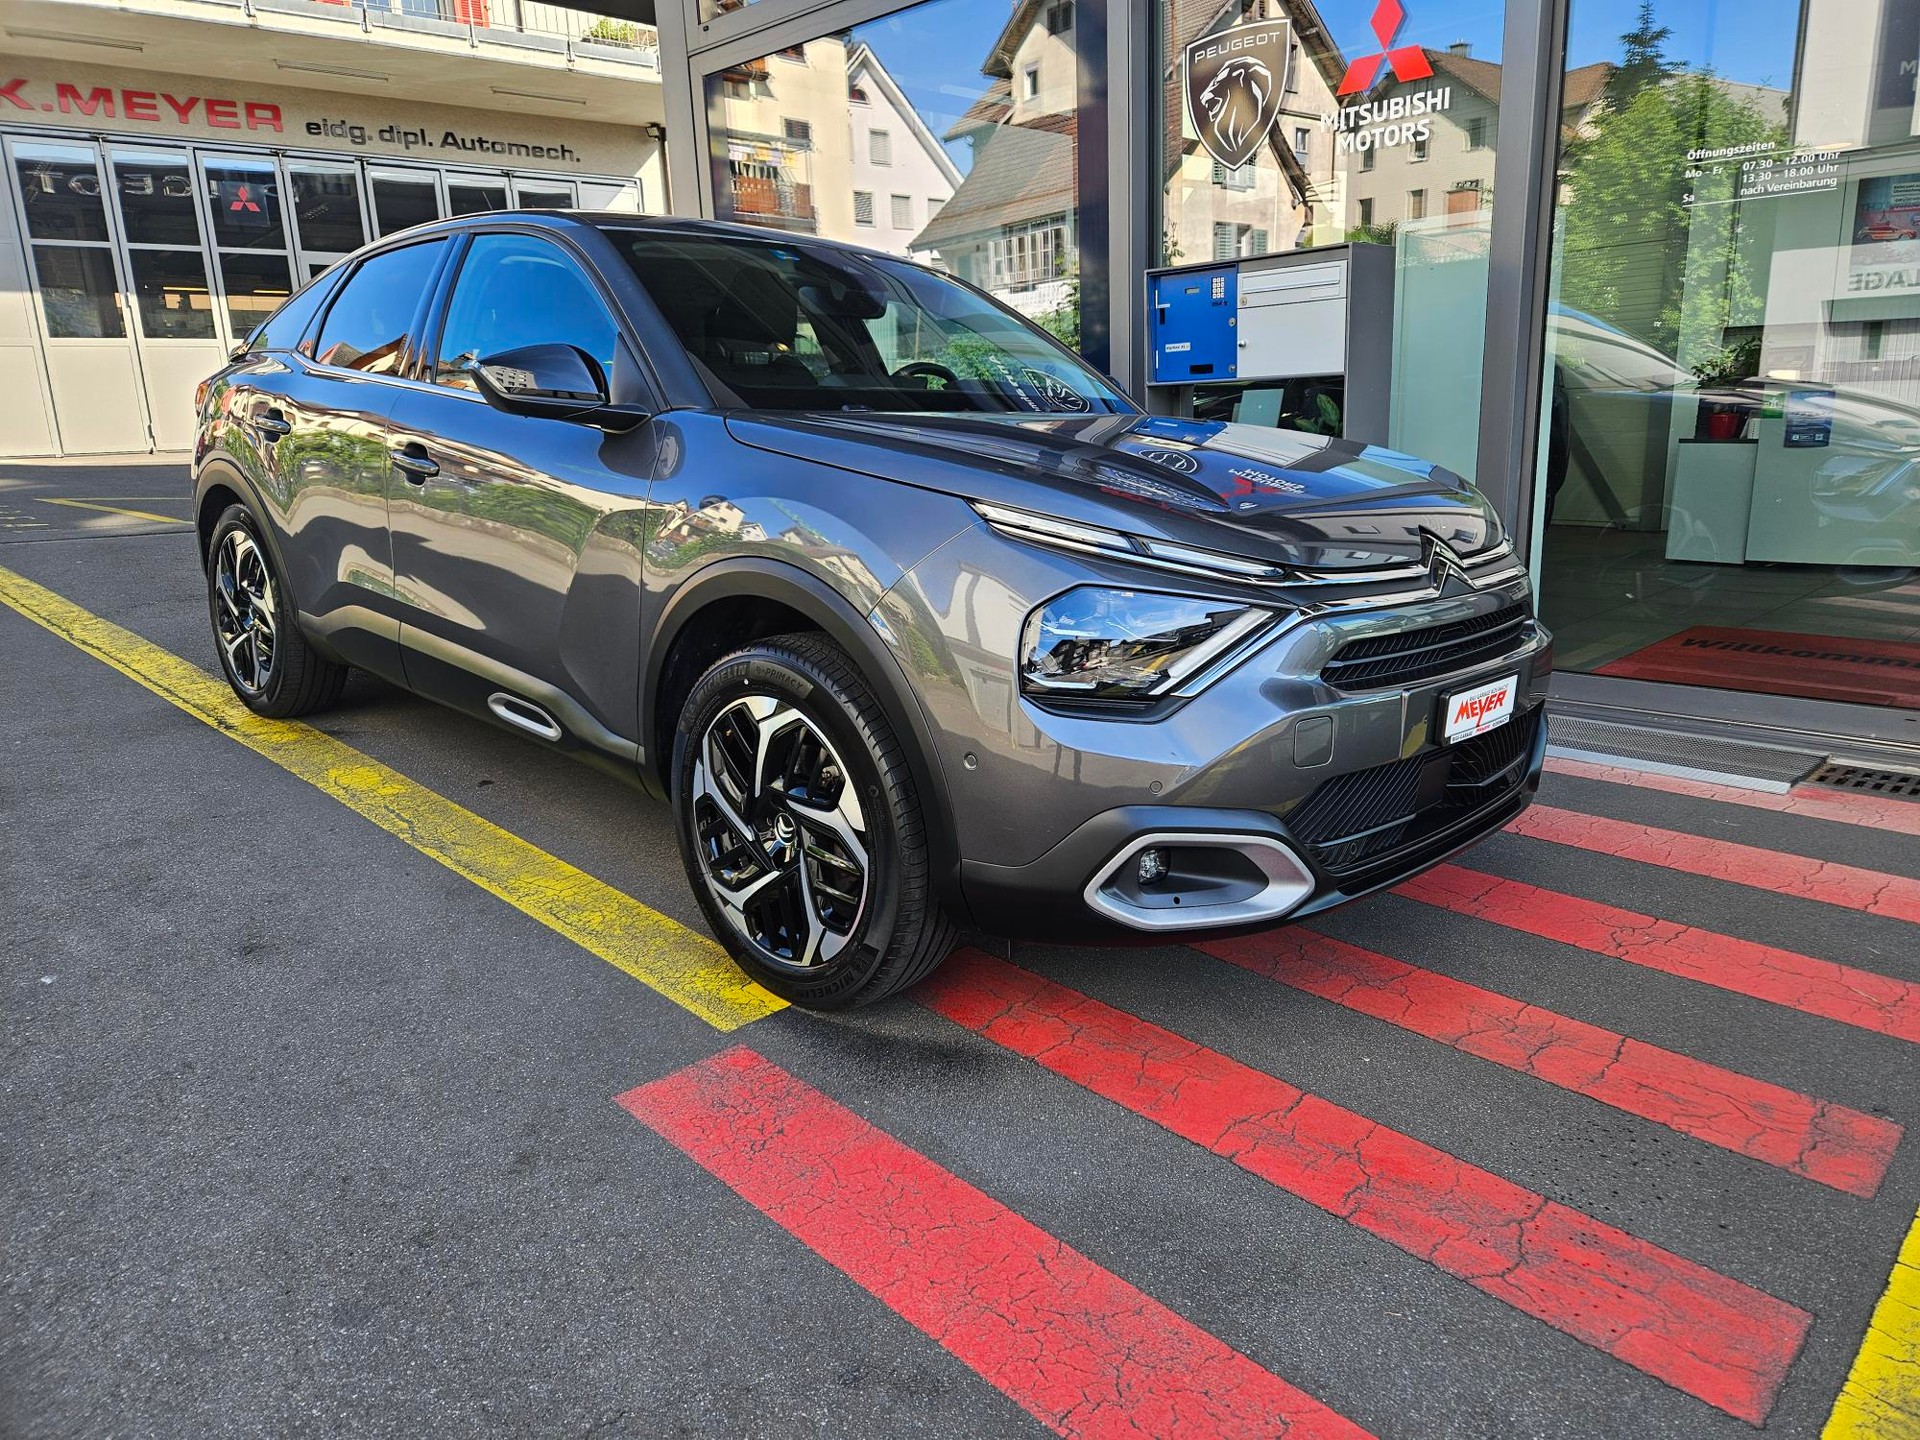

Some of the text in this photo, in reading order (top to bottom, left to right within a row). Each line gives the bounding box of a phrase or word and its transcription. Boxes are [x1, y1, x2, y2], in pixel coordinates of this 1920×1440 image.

[1194, 32, 1280, 64] PEUGEOT
[1320, 87, 1450, 132] MITSUBISHI
[305, 118, 581, 163] eidg. dipl. Automech.
[1336, 119, 1430, 155] MOTORS
[1687, 141, 1775, 161] Öffnungszeiten
[1685, 169, 1702, 179] Mo
[1713, 166, 1724, 175] Fr
[1743, 159, 1773, 171] 07.30
[1785, 154, 1815, 165] 12.00
[1819, 151, 1840, 161] Uhr
[1742, 171, 1772, 183] 13.30
[1784, 166, 1814, 178] 18.00
[1817, 163, 1839, 174] Uhr
[1682, 177, 1838, 202] Sa nach Vereinbarung
[1681, 637, 1920, 670] Willkomm
[1453, 689, 1507, 728] MEYER
